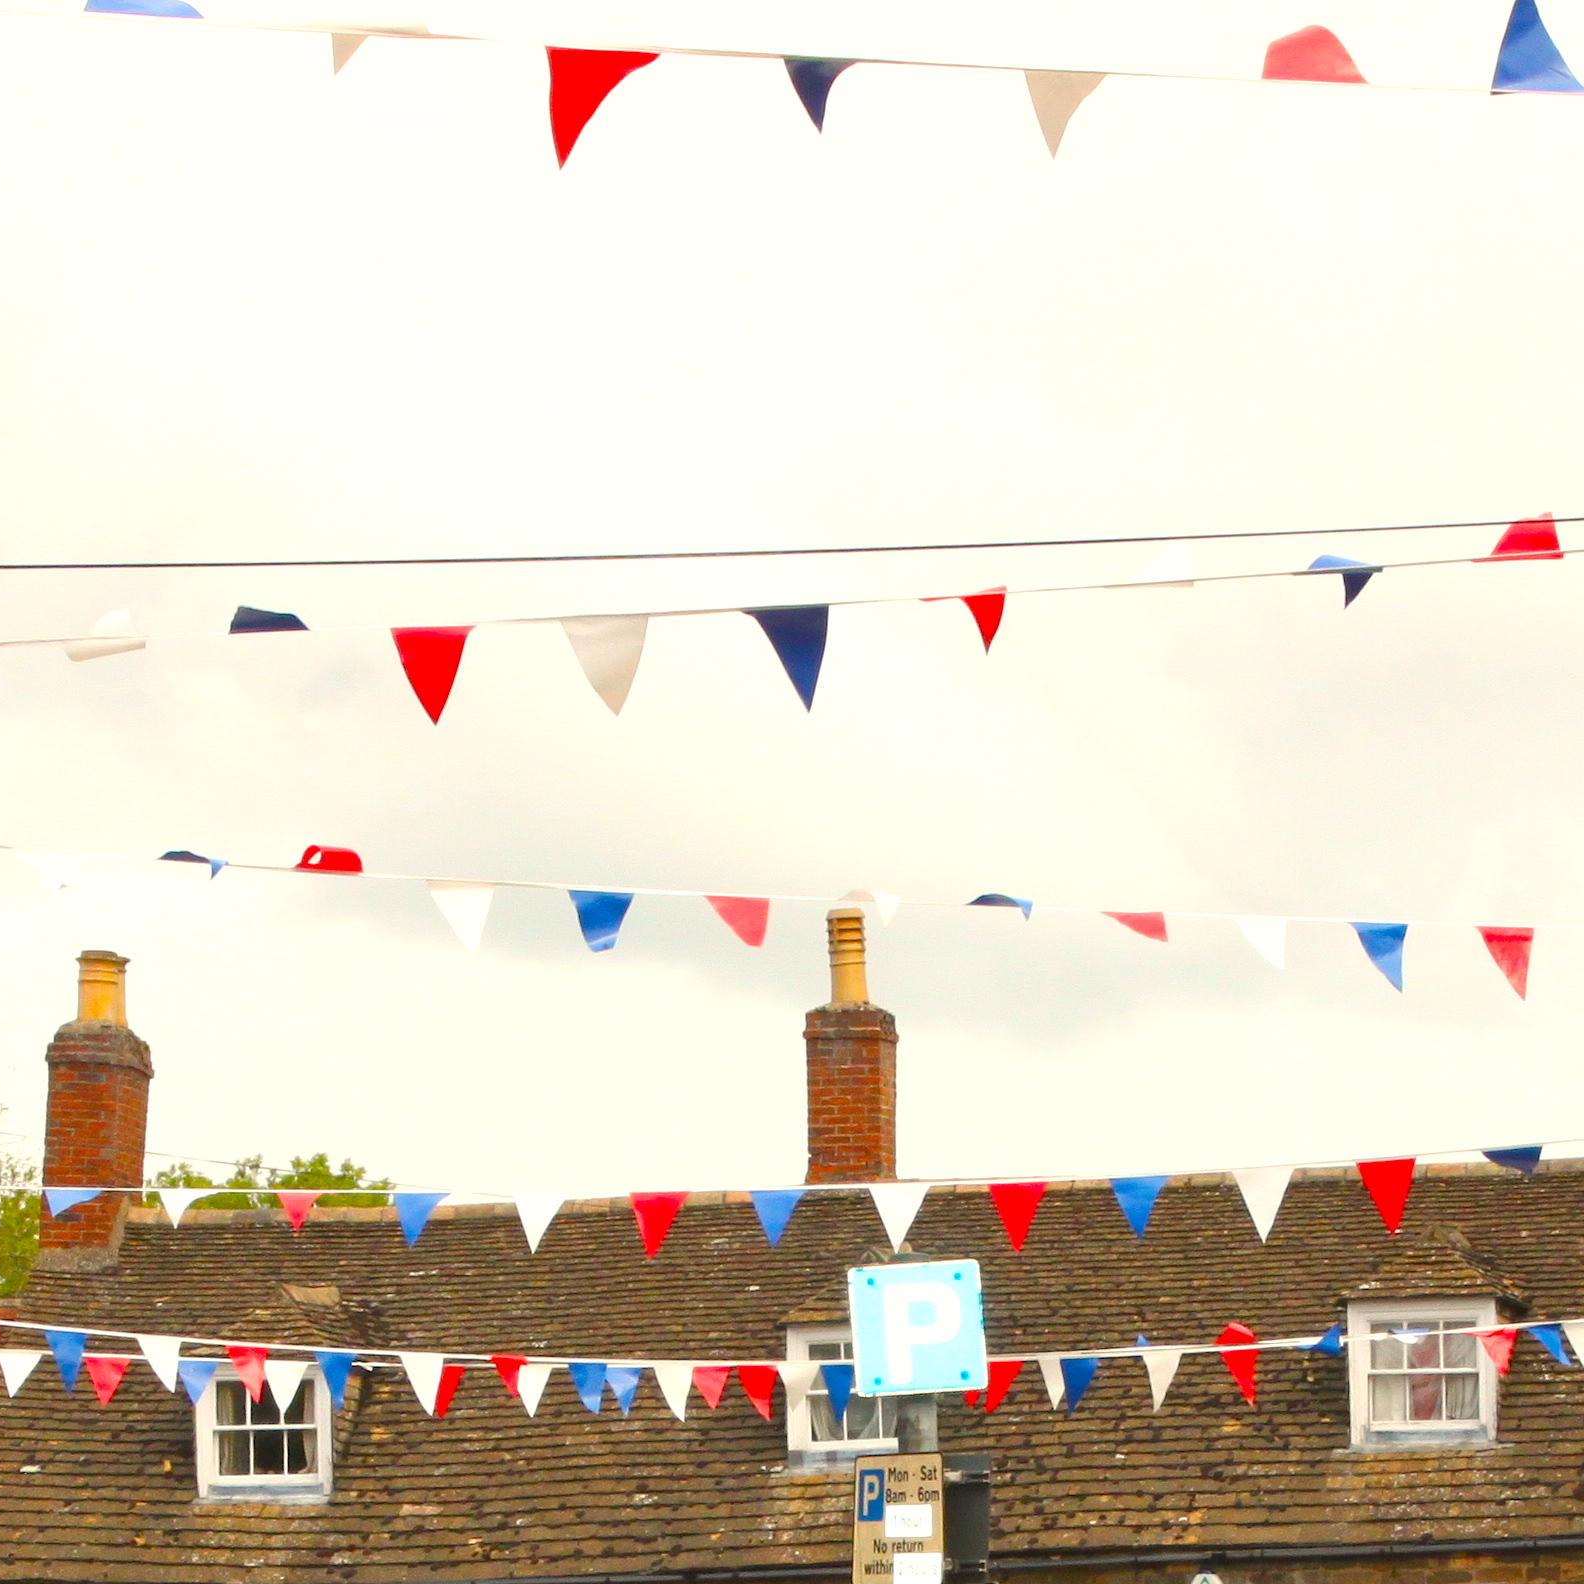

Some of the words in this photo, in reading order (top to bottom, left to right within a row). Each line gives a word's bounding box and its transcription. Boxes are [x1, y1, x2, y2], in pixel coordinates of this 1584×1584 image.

[881, 1281, 962, 1386] P
[888, 1467, 909, 1482] Mon
[919, 1465, 937, 1481] Sat
[862, 1475, 880, 1517] P
[885, 1488, 907, 1503] 8am
[917, 1486, 940, 1502] 6pm
[873, 1540, 888, 1553] No
[891, 1539, 924, 1553] return
[863, 1560, 894, 1575] within
